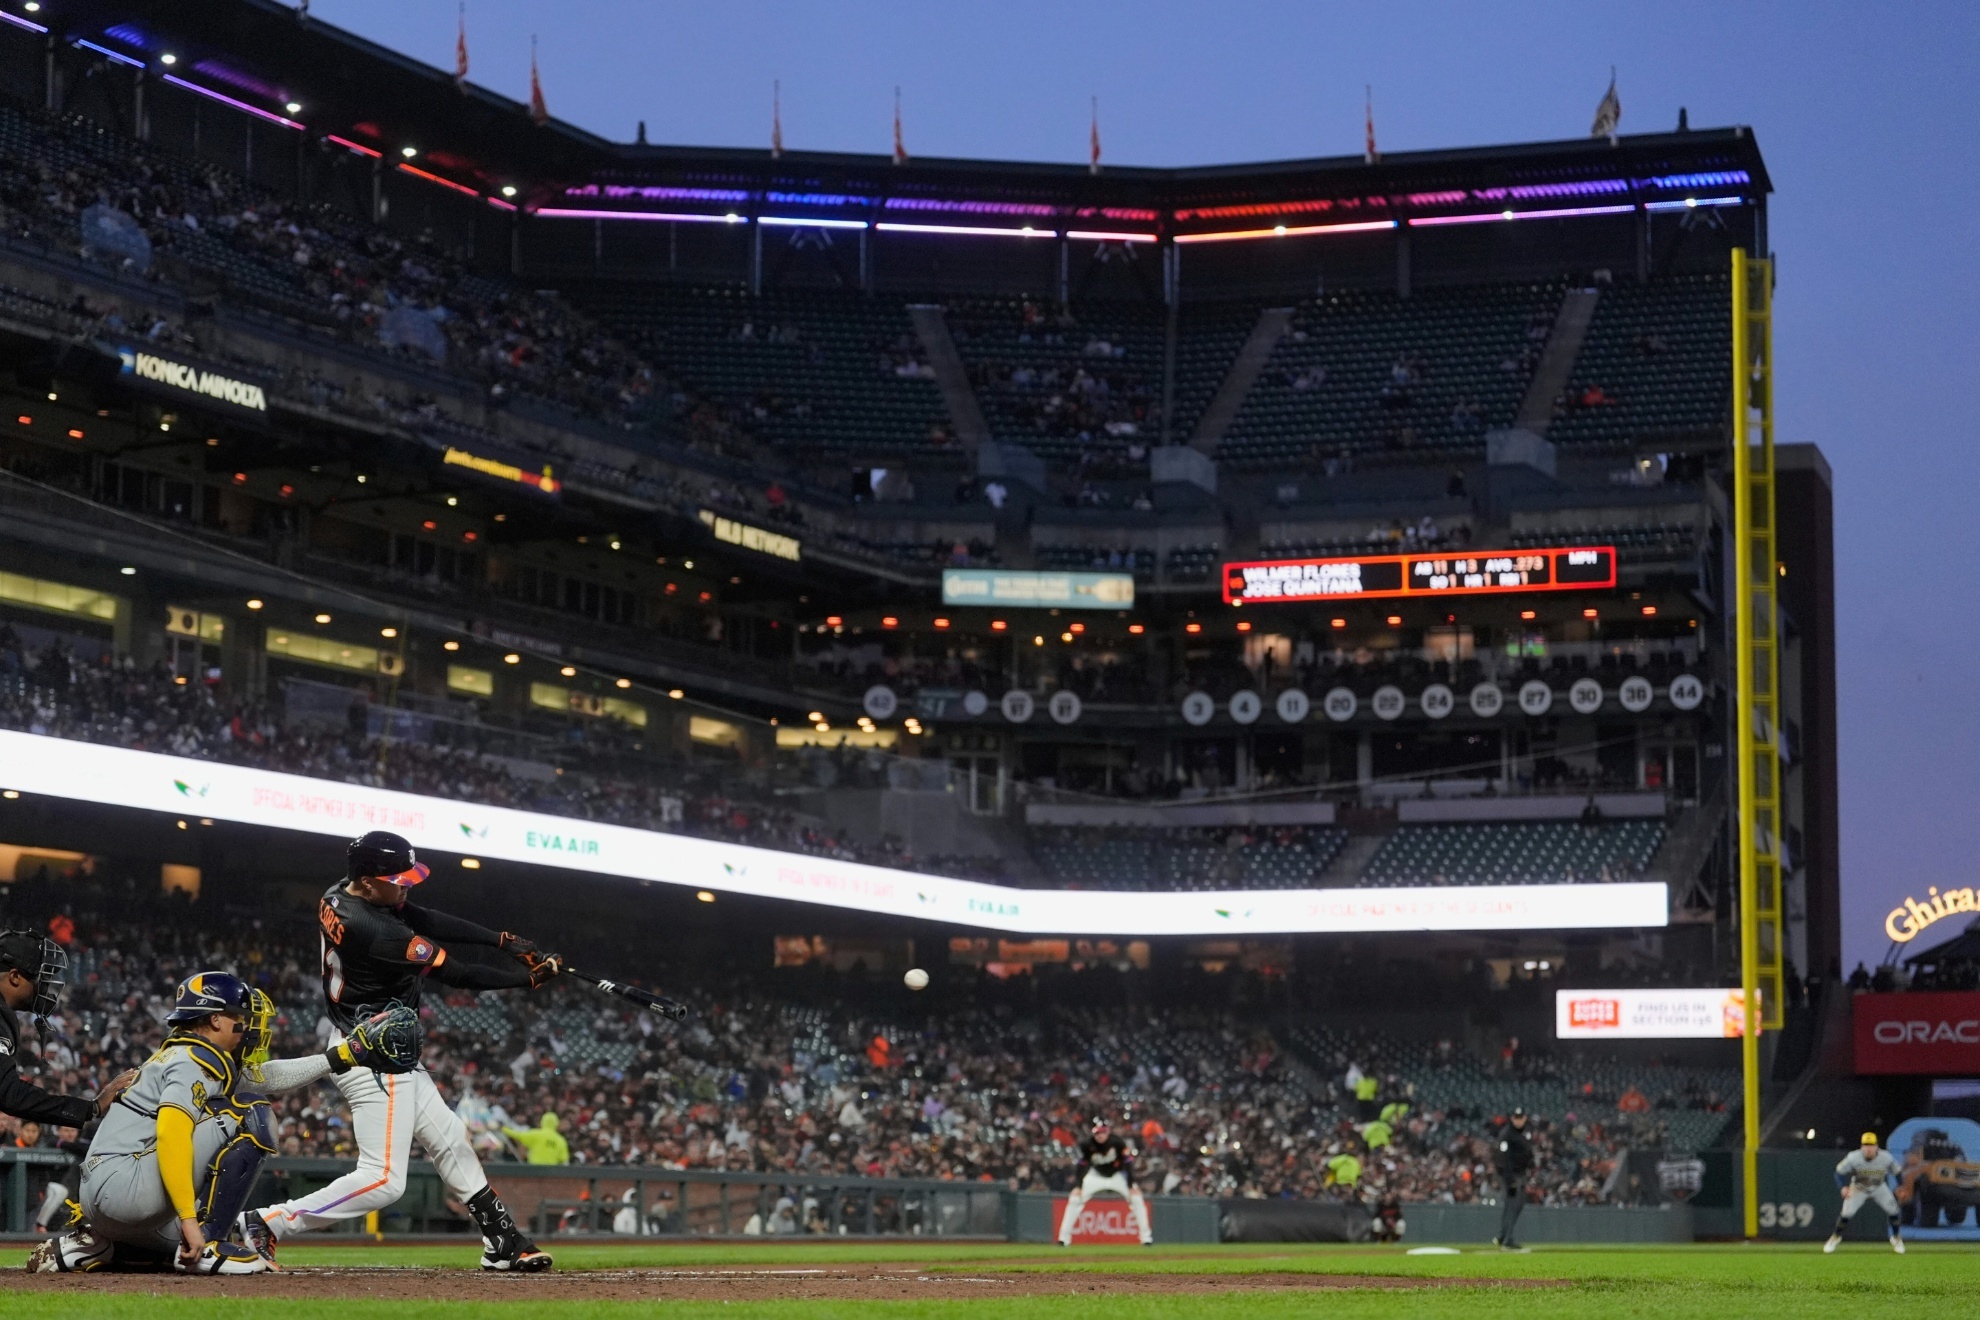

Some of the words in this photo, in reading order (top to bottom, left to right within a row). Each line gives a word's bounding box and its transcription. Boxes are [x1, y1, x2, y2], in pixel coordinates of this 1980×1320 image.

[135, 352, 198, 392] KONICA
[198, 371, 267, 411] MINOLTA
[742, 524, 800, 562] NETWORK
[1242, 564, 1303, 583] WILMER
[1303, 562, 1361, 581] FLORES
[1243, 580, 1283, 598] JOSE
[1282, 577, 1363, 597] QUINTANA
[1675, 683, 1697, 699] 44
[1638, 1003, 1669, 1012] FIND
[1672, 1003, 1689, 1012] US
[1692, 1003, 1706, 1012] IN
[1632, 1016, 1689, 1026] SECTION
[1759, 1202, 1814, 1228] 339
